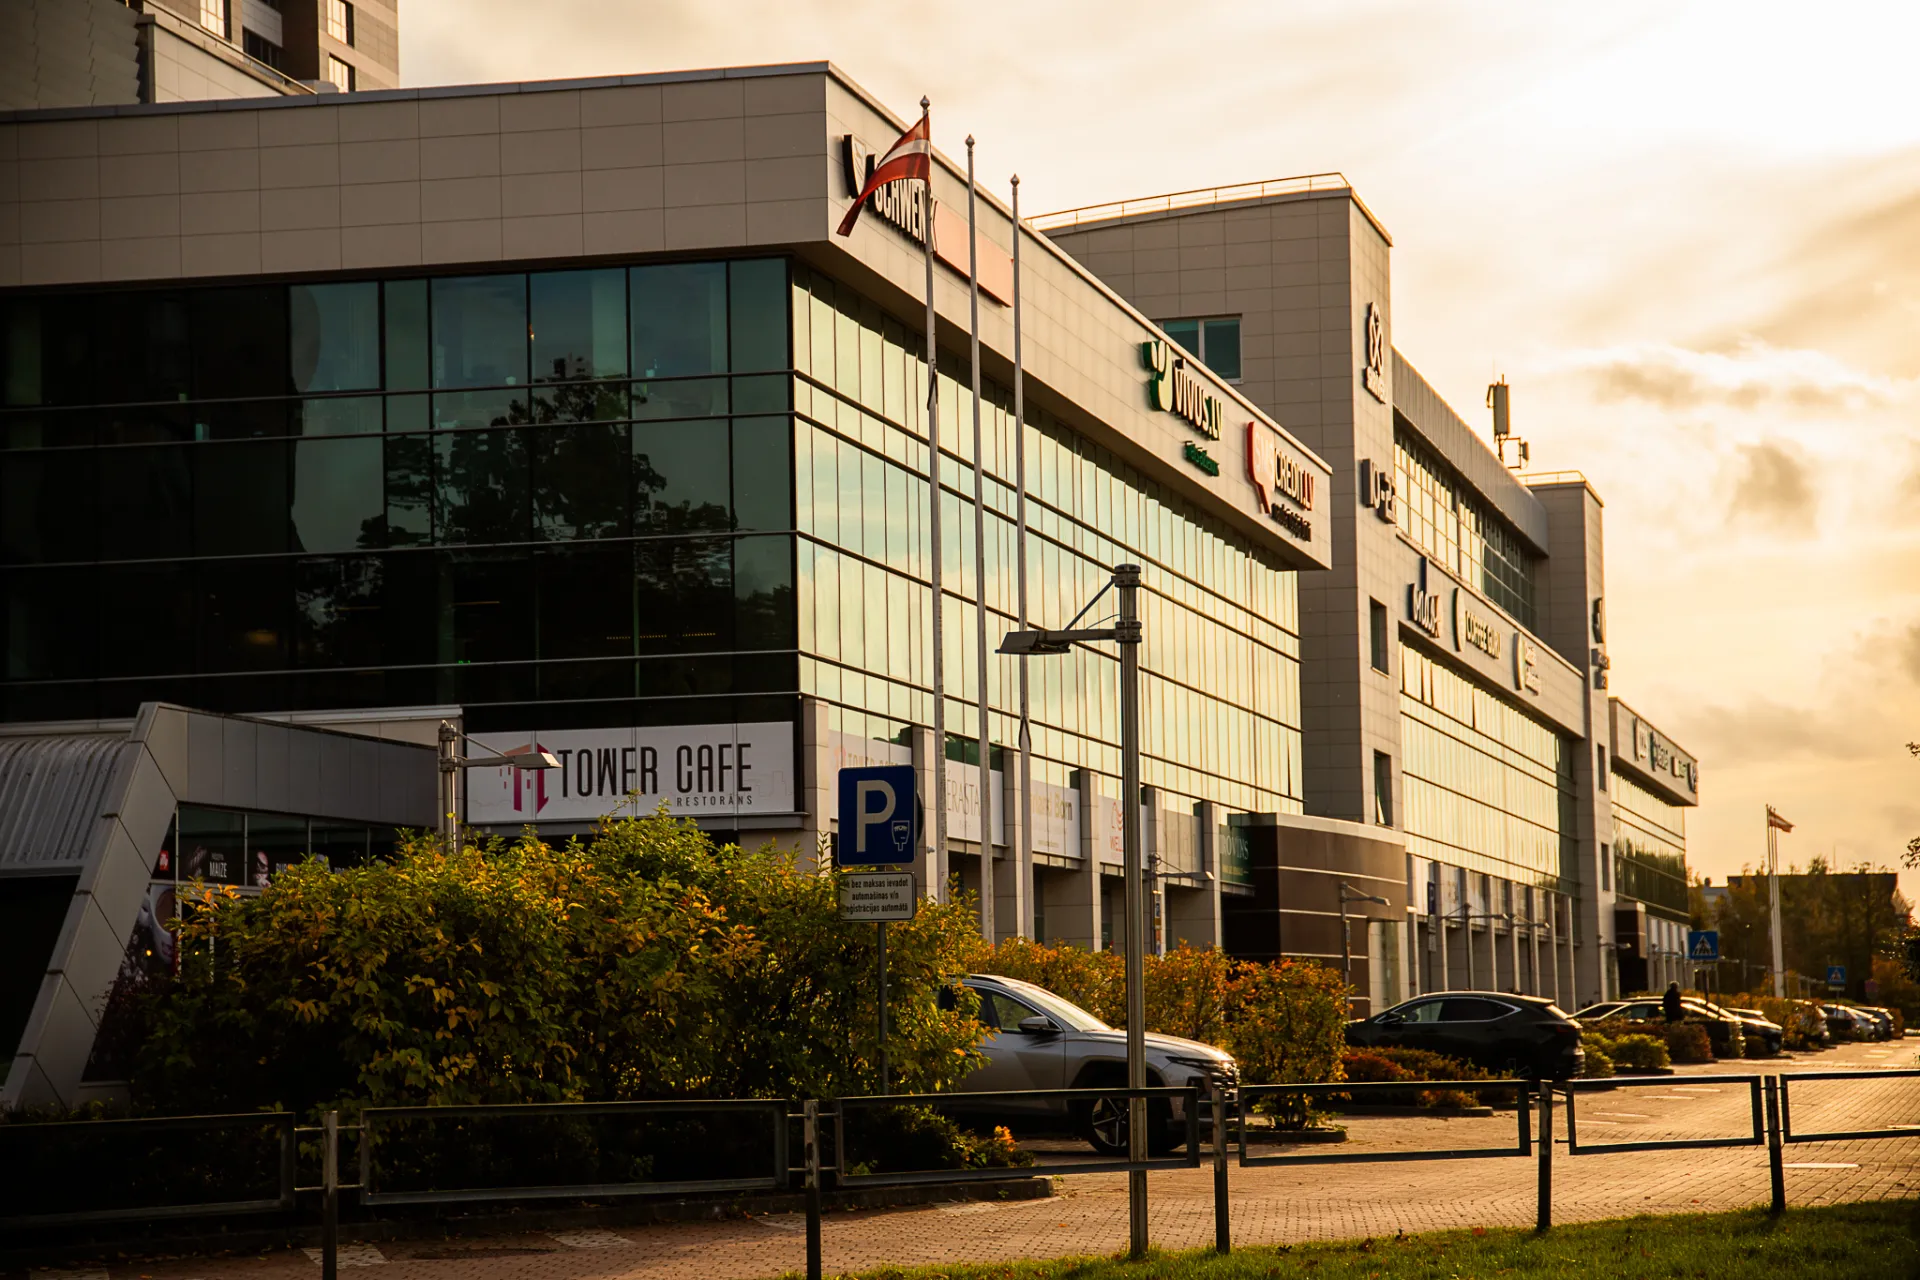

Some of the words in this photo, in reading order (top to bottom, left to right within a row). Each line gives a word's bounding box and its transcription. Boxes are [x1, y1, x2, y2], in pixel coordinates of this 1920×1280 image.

[557, 747, 658, 797] TOWER
[676, 742, 753, 793] CAFE
[676, 793, 753, 807] RESTORĀNS
[856, 779, 897, 853] P
[209, 861, 228, 879] MAIZE
[851, 879, 861, 888] bez
